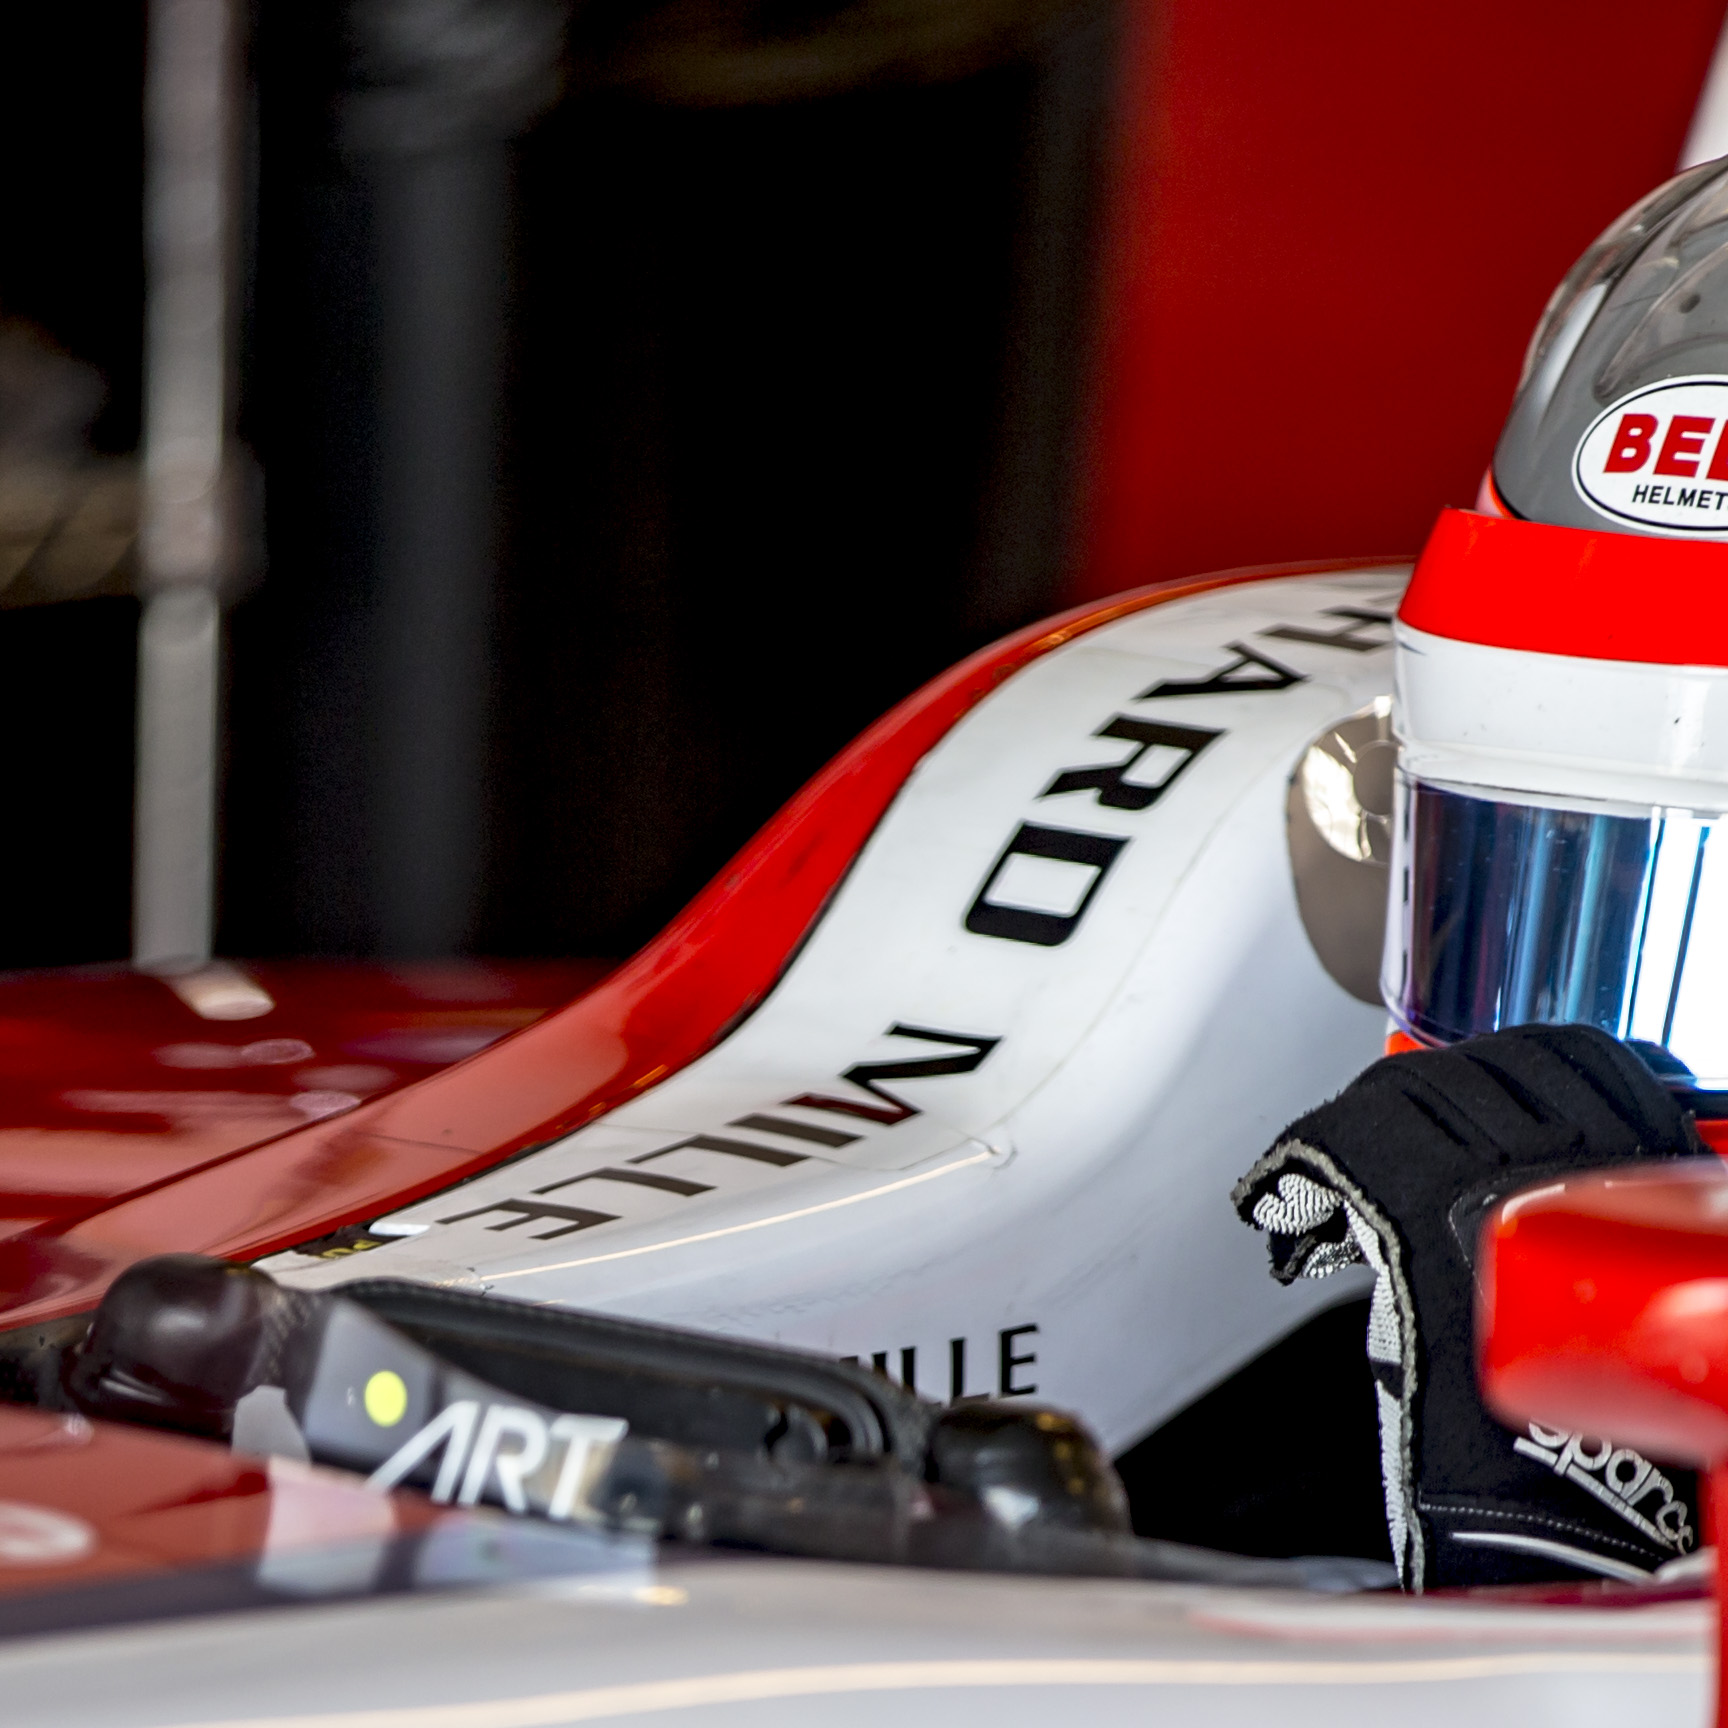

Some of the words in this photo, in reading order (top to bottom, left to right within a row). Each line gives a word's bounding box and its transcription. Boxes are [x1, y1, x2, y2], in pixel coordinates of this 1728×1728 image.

[964, 595, 1397, 947] HARD
[435, 1020, 1004, 1242] MILLE
[367, 1401, 629, 1522] ART
